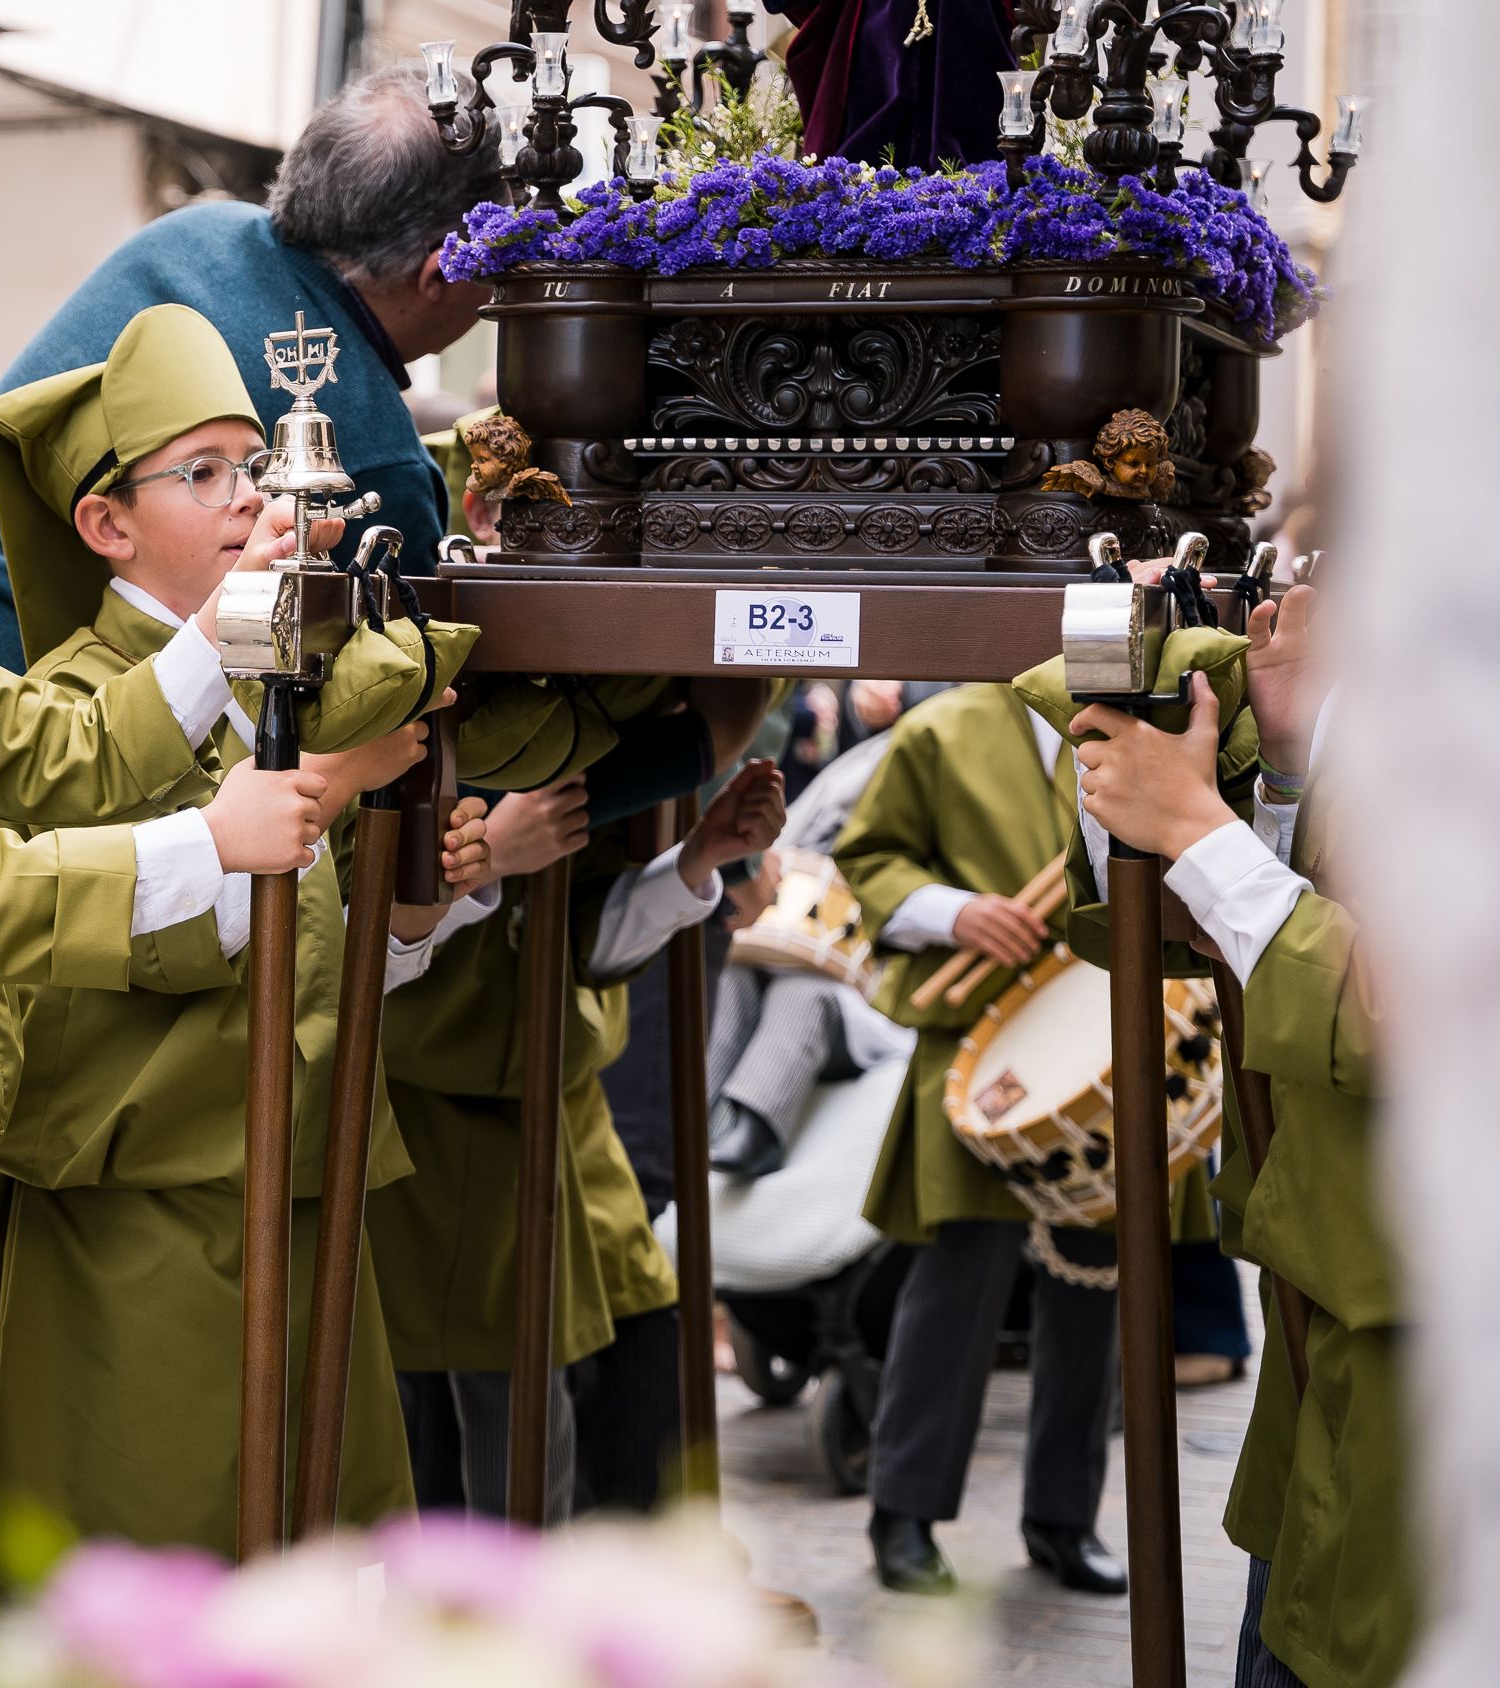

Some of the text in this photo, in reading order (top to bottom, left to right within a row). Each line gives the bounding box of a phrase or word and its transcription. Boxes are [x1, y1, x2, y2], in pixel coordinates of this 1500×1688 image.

[543, 282, 571, 299] TU
[720, 282, 736, 298] A
[828, 282, 892, 298] FIAT
[749, 604, 814, 631] B2-3
[744, 648, 830, 658] AETERNUM
